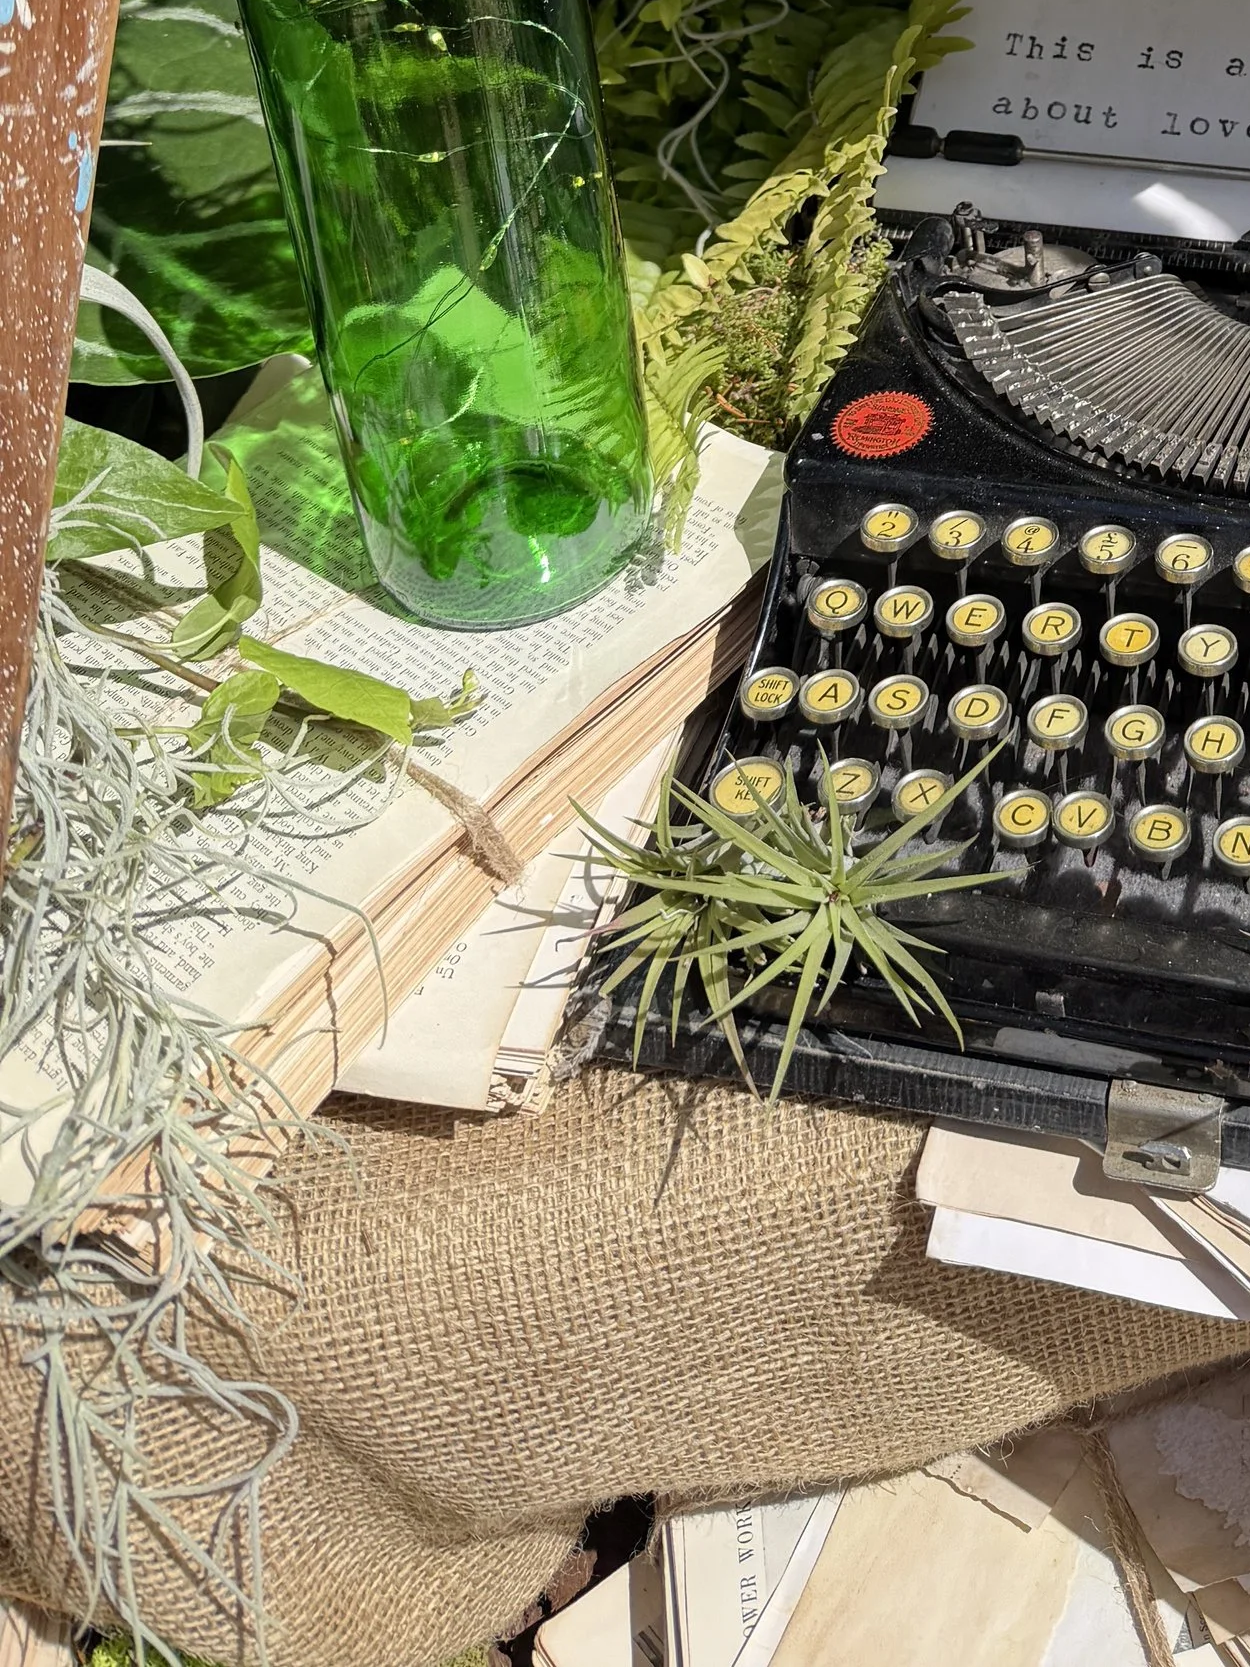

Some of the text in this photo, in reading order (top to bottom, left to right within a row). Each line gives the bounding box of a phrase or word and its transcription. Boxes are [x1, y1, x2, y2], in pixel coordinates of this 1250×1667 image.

[1005, 32, 1095, 62] This
[1138, 45, 1184, 70] is
[1225, 56, 1247, 77] a
[992, 96, 1119, 129] about
[692, 509, 709, 519] tall
[876, 520, 898, 538] 2
[1015, 537, 1035, 554] 4
[1096, 543, 1114, 560] 5
[185, 555, 197, 564] the
[1171, 552, 1190, 571] 6
[287, 575, 305, 591] best,
[307, 590, 320, 599] the
[825, 590, 849, 615] Q
[606, 611, 624, 624] best
[616, 604, 635, 614] and
[891, 598, 921, 620] W
[964, 607, 988, 627] E
[325, 619, 351, 636] anchor
[334, 610, 368, 631] watched
[589, 614, 614, 633] living
[1040, 615, 1066, 636] R
[315, 627, 332, 640] lan-
[560, 628, 586, 643] place
[582, 627, 603, 640] their
[1124, 628, 1145, 648] T
[304, 633, 338, 660] his wife,
[338, 642, 357, 656] with
[367, 631, 400, 654] Godard
[495, 635, 523, 652] selling
[553, 640, 570, 654] The
[1200, 637, 1222, 658] Y
[101, 648, 115, 660] the
[365, 644, 402, 669] dropped
[405, 653, 428, 670] strait.
[408, 622, 514, 694] Grim neither gold
[471, 650, 488, 661] not
[529, 642, 569, 666] could, he
[358, 655, 381, 671] shore
[484, 644, 547, 684] feared that the
[486, 660, 505, 672] did
[539, 662, 558, 673] and
[380, 670, 396, 681] the
[400, 667, 420, 680] and
[419, 648, 512, 709] from and was
[427, 669, 442, 679] the
[506, 672, 518, 682] he
[122, 681, 140, 696] and
[419, 678, 436, 692] sail,
[519, 680, 536, 693] but
[757, 677, 791, 691] SHIFT
[754, 691, 785, 705] LOCK
[817, 683, 839, 703] A
[886, 689, 910, 710] S
[964, 697, 990, 718] D
[1047, 708, 1069, 728] F
[1121, 719, 1147, 742] G
[1200, 730, 1226, 754] H
[417, 746, 441, 766] down
[836, 772, 861, 794] Z
[735, 789, 763, 801] KE
[909, 782, 938, 805] X
[1011, 803, 1036, 826] C
[1076, 805, 1098, 828] V
[1147, 820, 1172, 842] B
[311, 844, 331, 860] and
[331, 839, 343, 849] us
[295, 850, 318, 874] King
[230, 886, 246, 900] cut
[264, 892, 281, 906] the
[173, 932, 214, 968] the boy's
[174, 955, 201, 982] hand,
